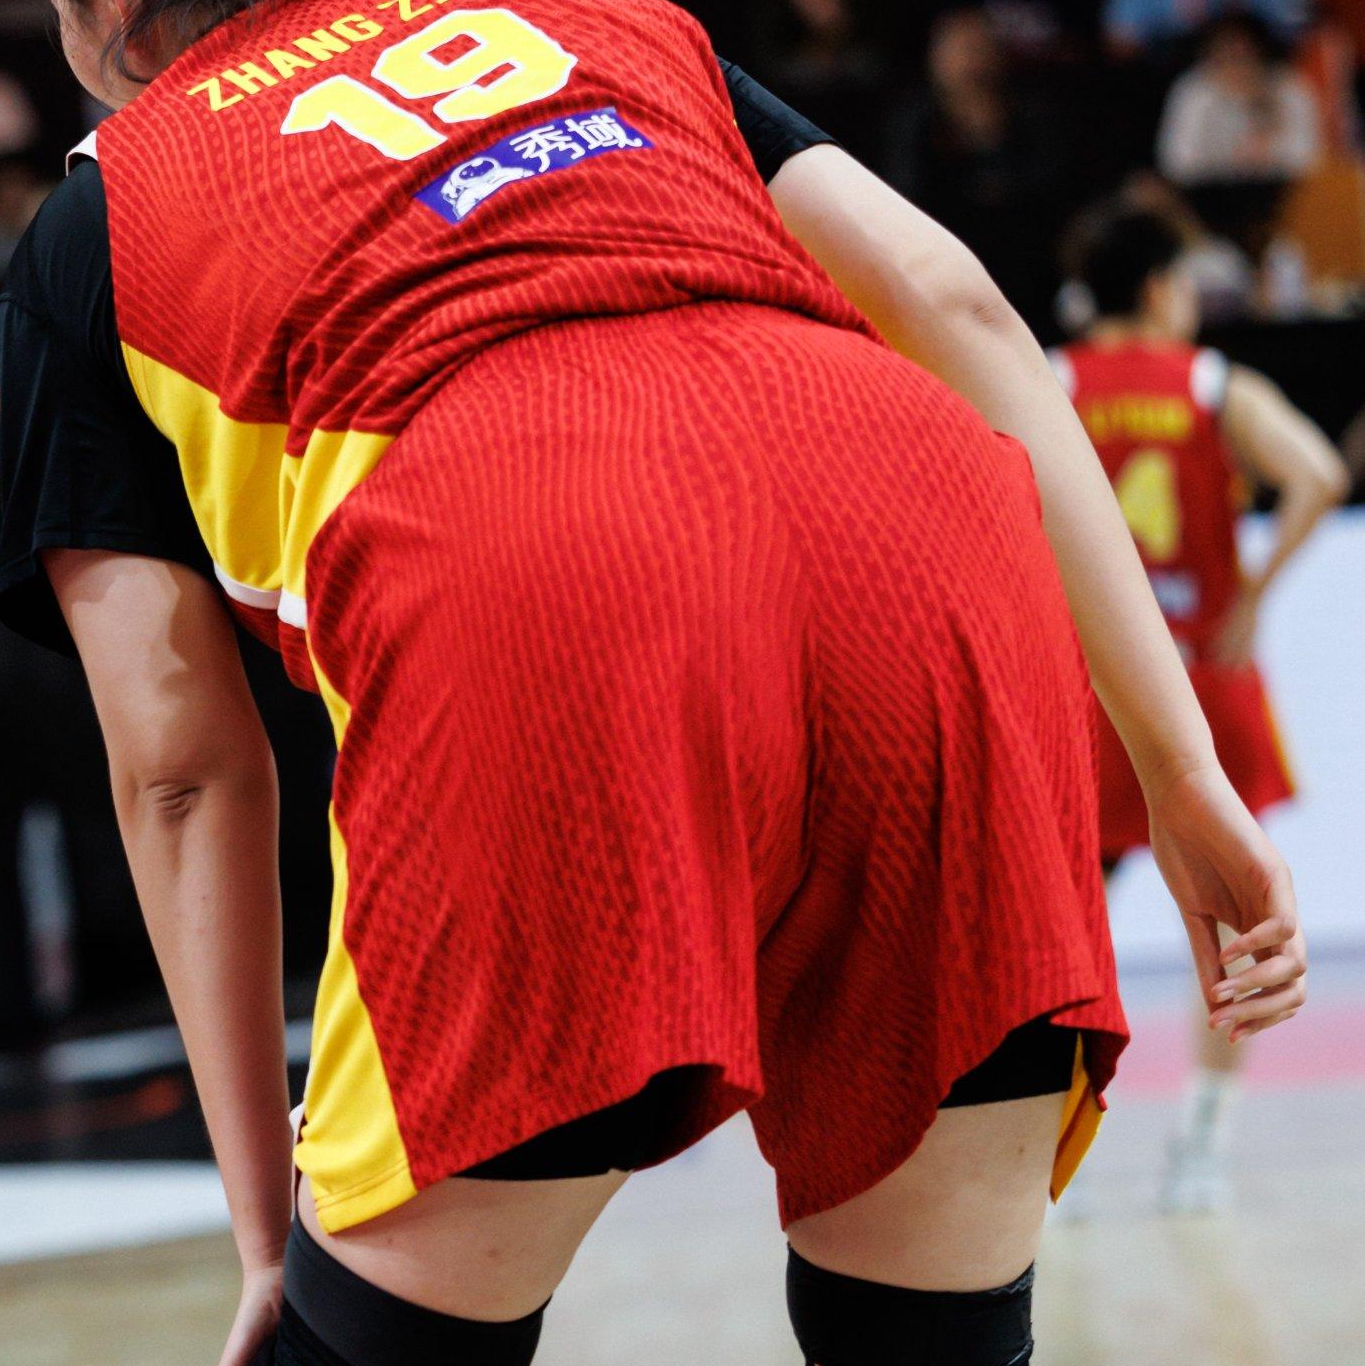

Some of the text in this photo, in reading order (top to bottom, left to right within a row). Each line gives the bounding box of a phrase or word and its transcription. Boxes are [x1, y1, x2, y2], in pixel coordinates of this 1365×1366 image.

[185, 13, 385, 113] ZHANG
[280, 7, 578, 161] 19
[508, 113, 644, 174] 秀域
